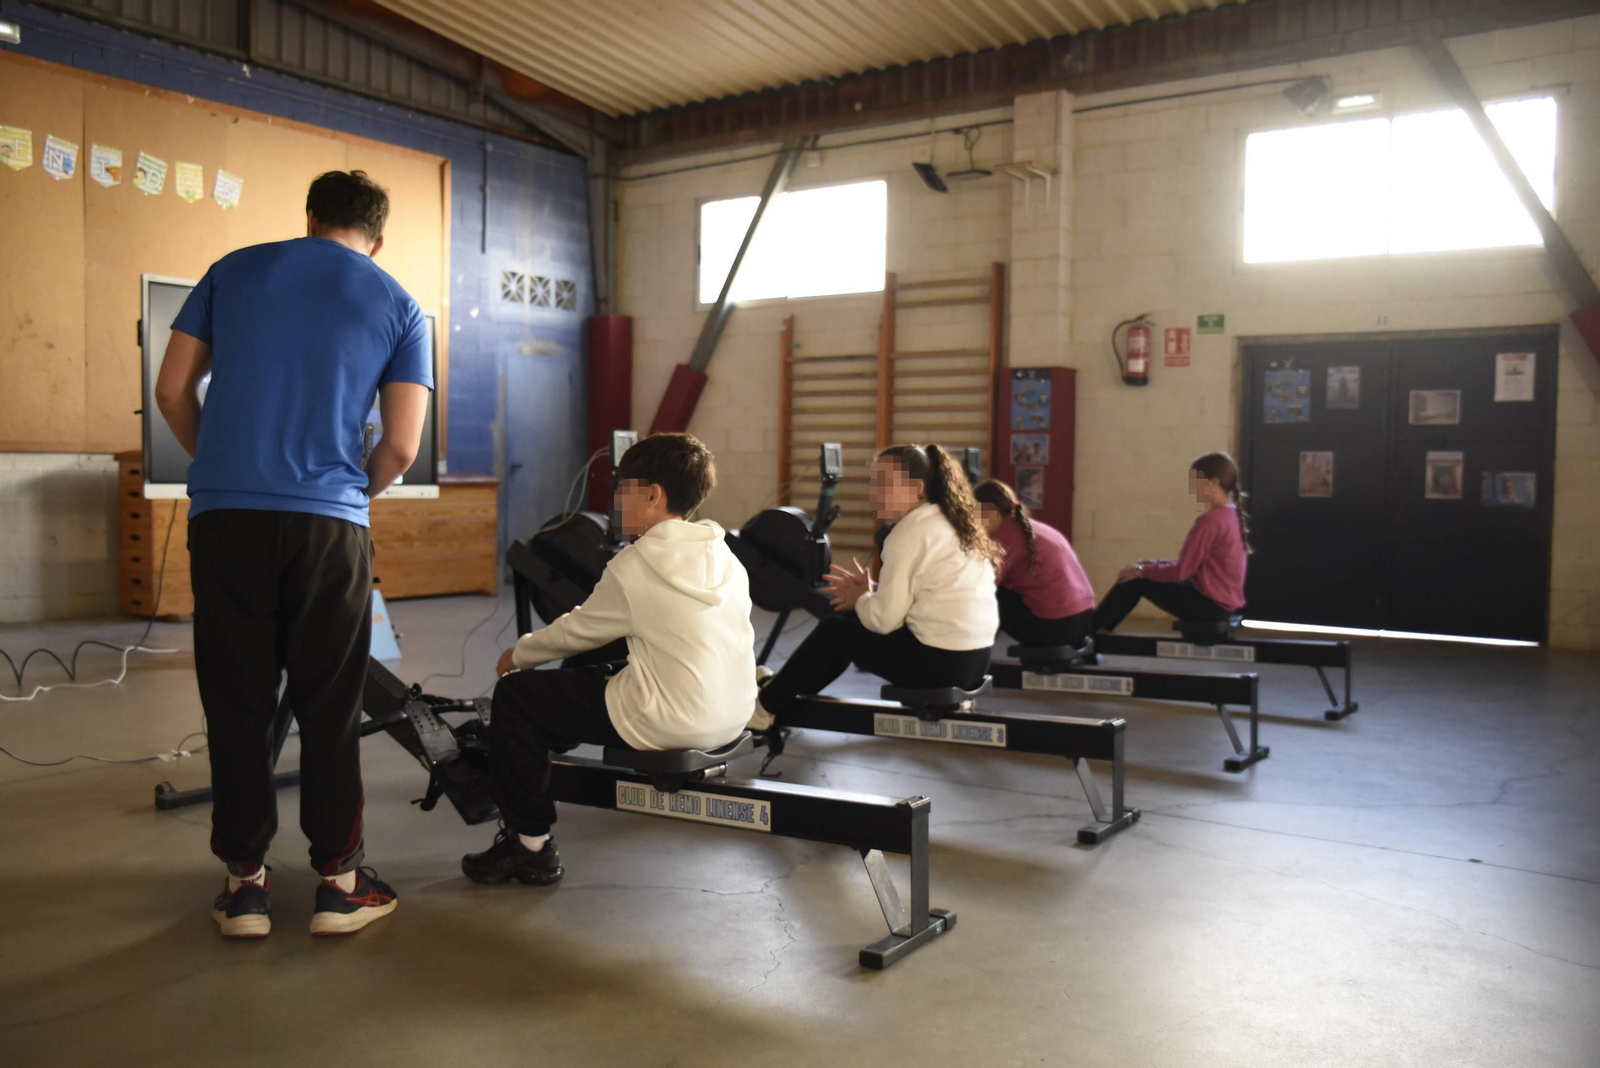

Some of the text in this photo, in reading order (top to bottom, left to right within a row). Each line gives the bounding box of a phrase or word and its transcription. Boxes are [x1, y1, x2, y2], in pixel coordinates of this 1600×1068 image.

[876, 717, 899, 734] CLUB
[903, 719, 916, 736] DE
[996, 727, 1004, 744] 3
[618, 785, 768, 825] CLUB DE REMO LINENSE 4
